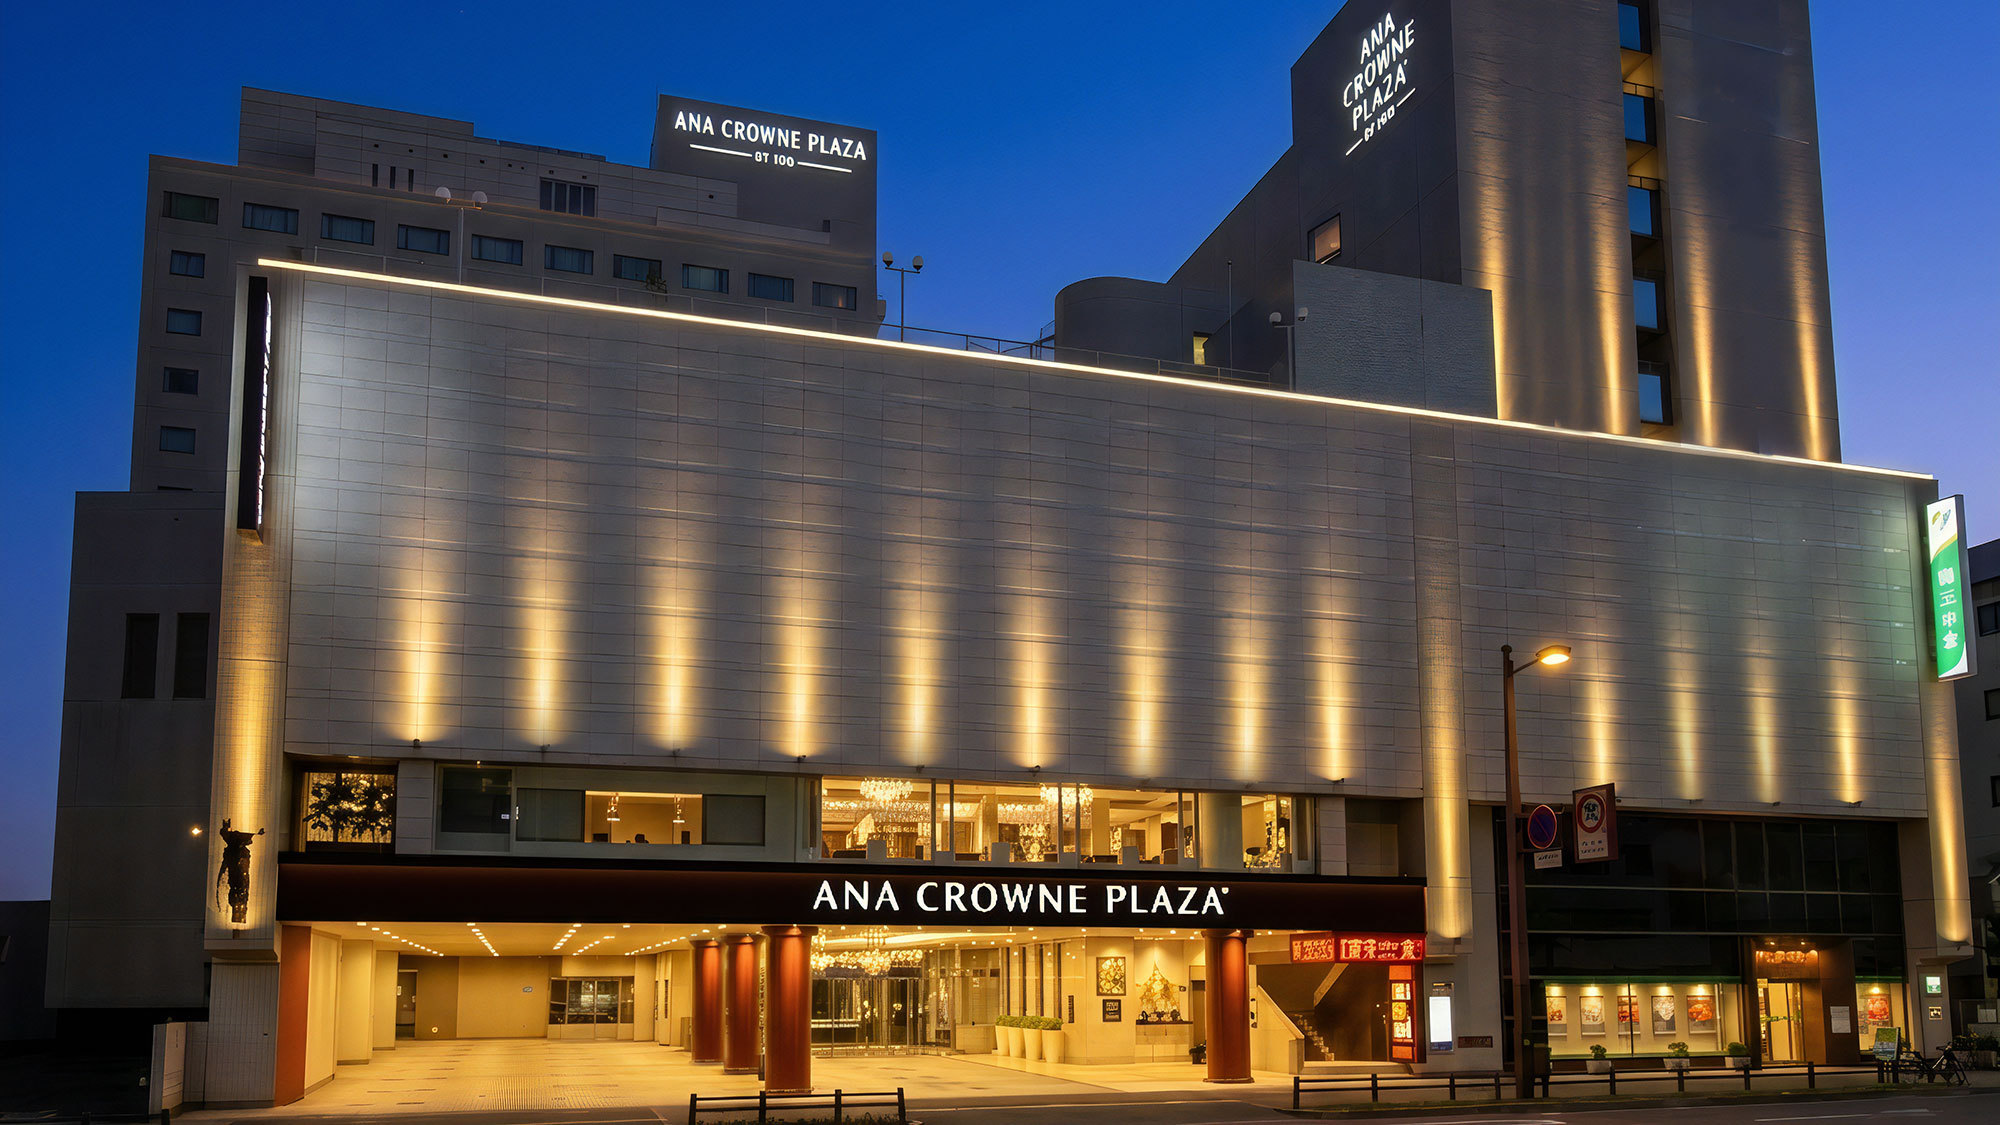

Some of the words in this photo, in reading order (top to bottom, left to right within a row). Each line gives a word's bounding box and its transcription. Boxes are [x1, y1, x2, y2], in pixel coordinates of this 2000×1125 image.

[1343, 18, 1415, 108] CROWNE
[1361, 12, 1396, 65] ANA
[1352, 59, 1408, 132] PLAZA
[674, 110, 714, 136] ANA
[721, 119, 801, 150] CROWNE
[808, 133, 867, 161] PLAZA
[813, 880, 900, 911] ANA
[916, 882, 1087, 913] CROWNE
[1106, 885, 1228, 915] PLAZA
